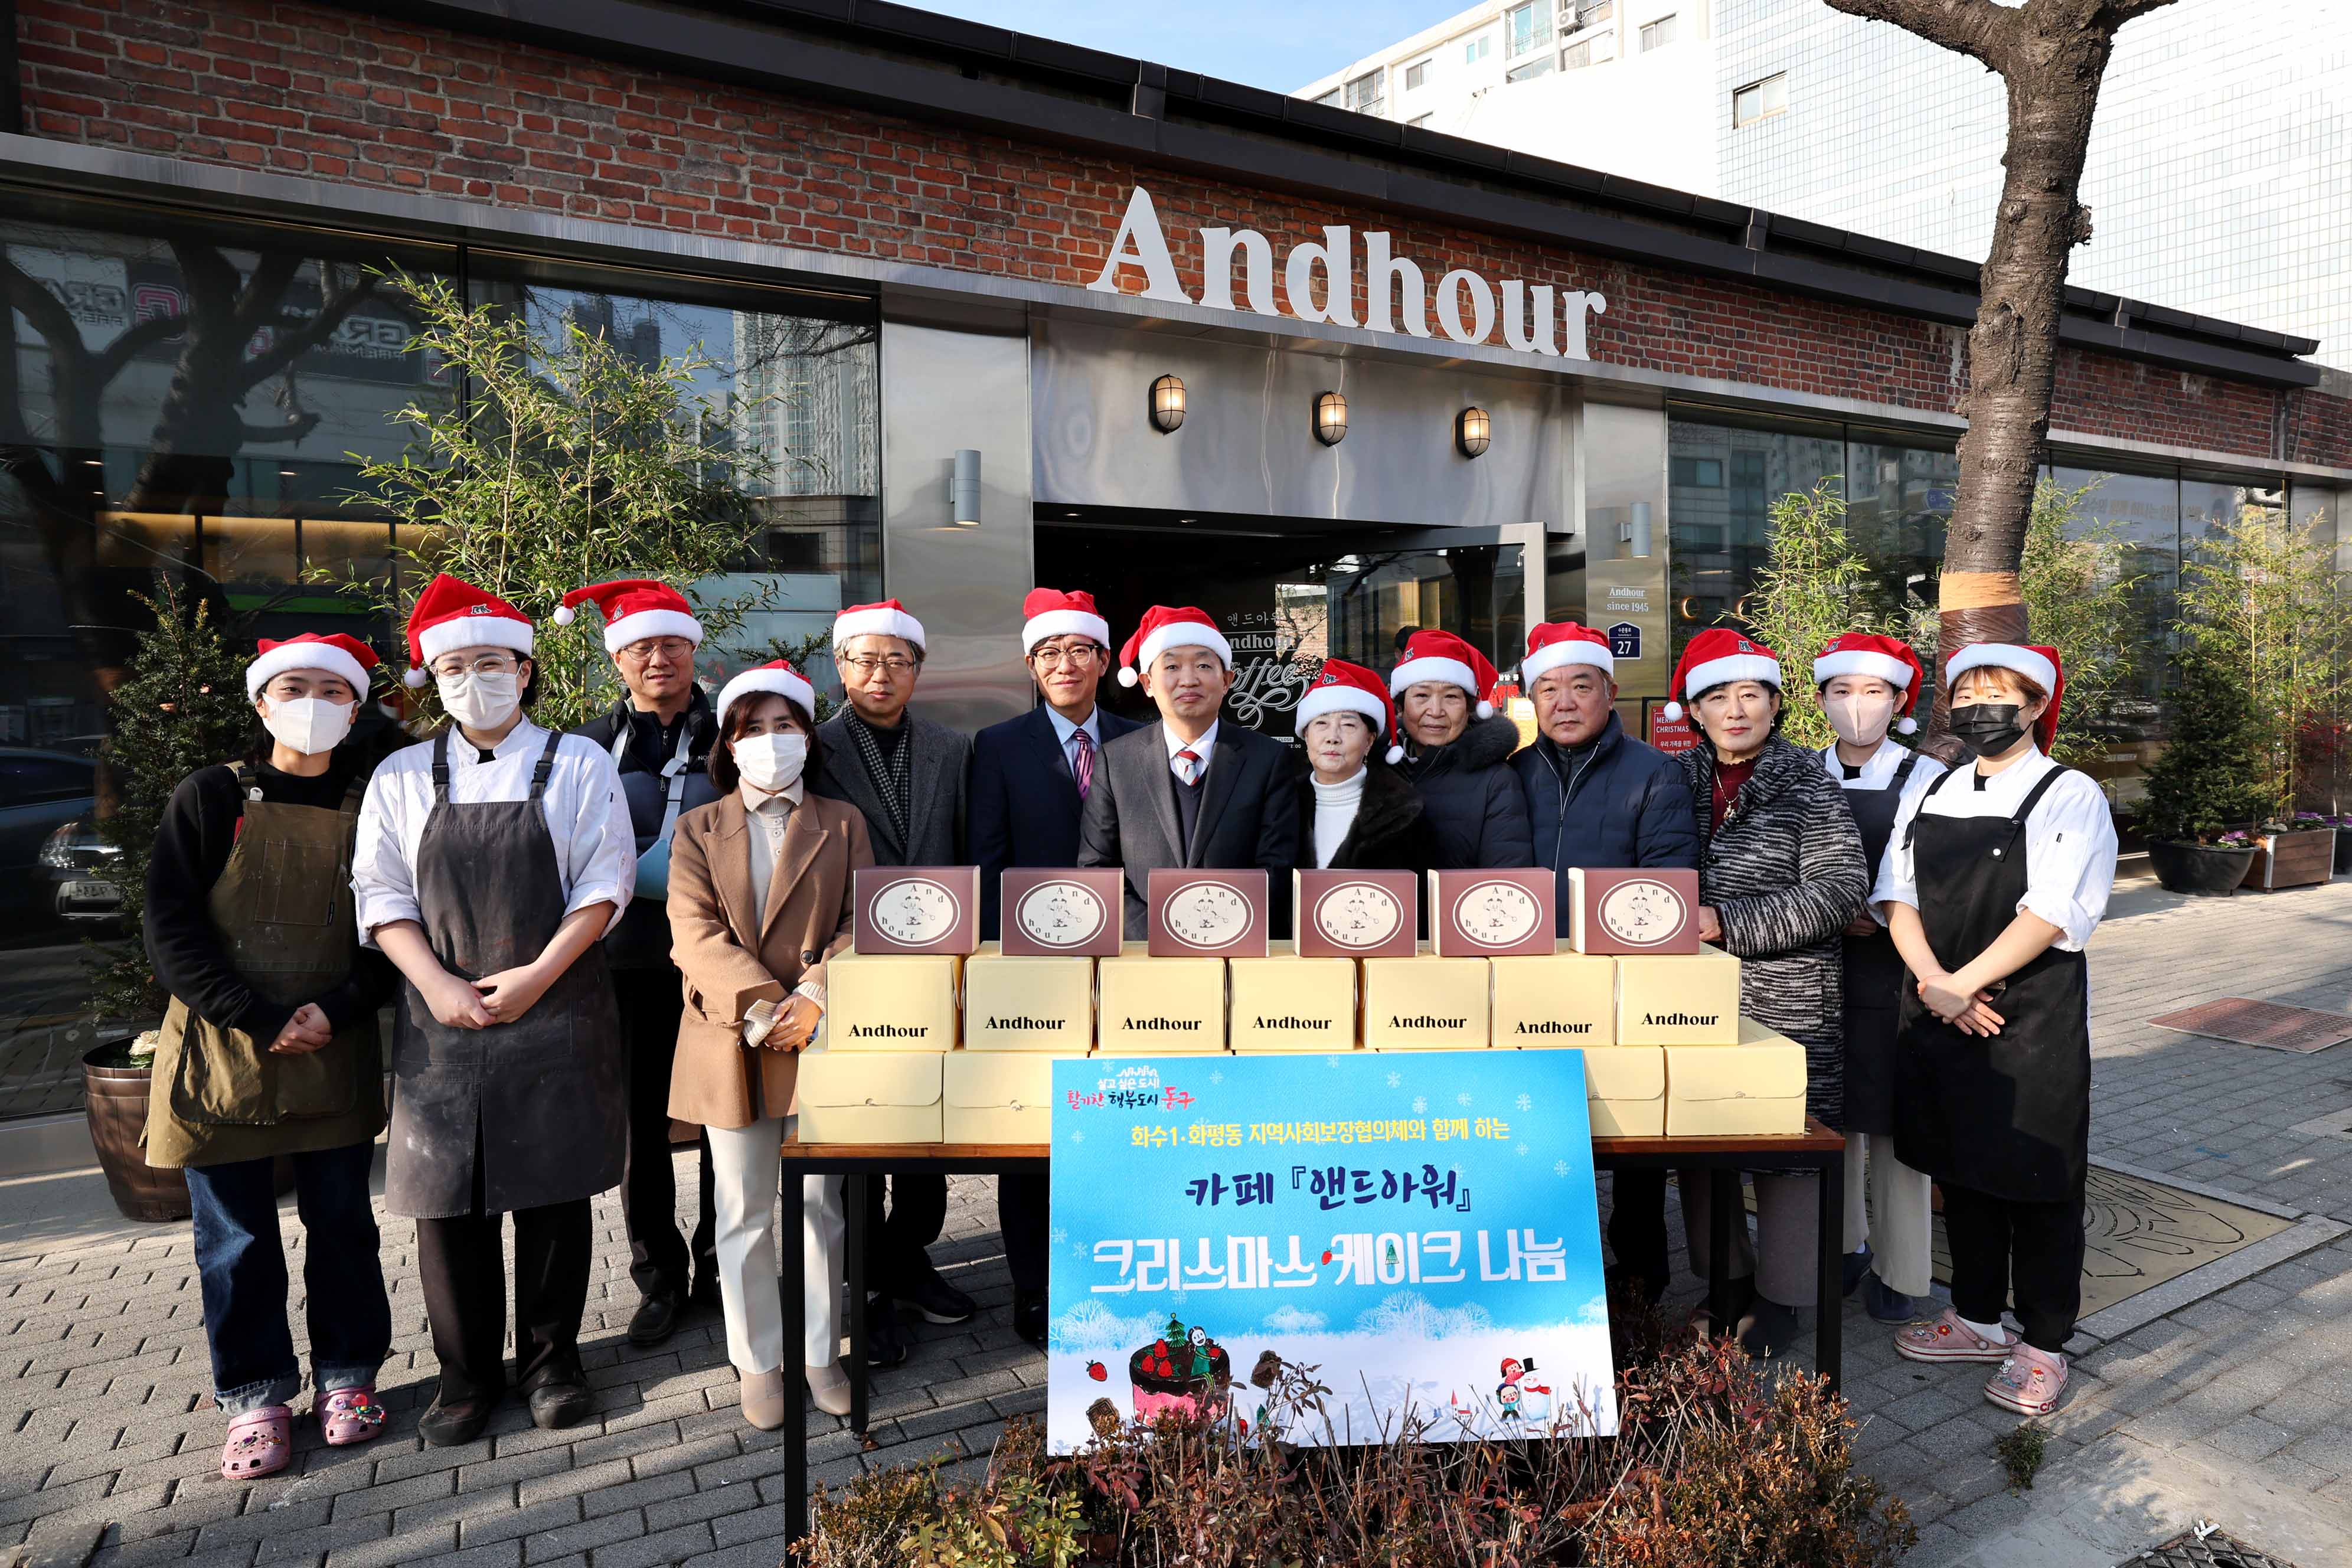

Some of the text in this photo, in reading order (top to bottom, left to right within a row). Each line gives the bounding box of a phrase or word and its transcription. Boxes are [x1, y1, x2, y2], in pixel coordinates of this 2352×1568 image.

[1086, 185, 1606, 361] Andhour
[1609, 587, 1645, 597] Andhour
[1607, 602, 1649, 612] since 1945
[1618, 641, 1632, 655] 27
[910, 884, 944, 903] And
[1057, 886, 1090, 906] And
[1203, 887, 1237, 906] And
[1354, 888, 1387, 907] And
[1492, 887, 1525, 905] And
[1638, 886, 1670, 904] And
[882, 916, 915, 939] hour
[1029, 919, 1062, 942] hour
[1175, 919, 1208, 943] hour
[1327, 920, 1360, 943] hour
[1465, 919, 1498, 941] hour
[1611, 917, 1644, 940] hour
[985, 1016, 1066, 1031] Andhour
[1122, 1016, 1202, 1031] Andhour
[1252, 1015, 1332, 1030] Andhour
[1389, 1015, 1467, 1029] Andhour
[1514, 1020, 1593, 1034] Andhour
[1641, 1012, 1719, 1026] Andhour
[848, 1024, 929, 1038] Andhour
[1097, 1078, 1116, 1090] 살고
[1118, 1078, 1137, 1090] 싶은
[1067, 1086, 1196, 1110] 활기찬 행복도시 동구
[1249, 1119, 1426, 1146] 지역사회보장협의체와
[1433, 1118, 1469, 1142] 함께
[1474, 1118, 1510, 1141] 하는
[1185, 1171, 1275, 1207] 카페
[1090, 1228, 1567, 1293] 크리스마스 케이크 나눔
